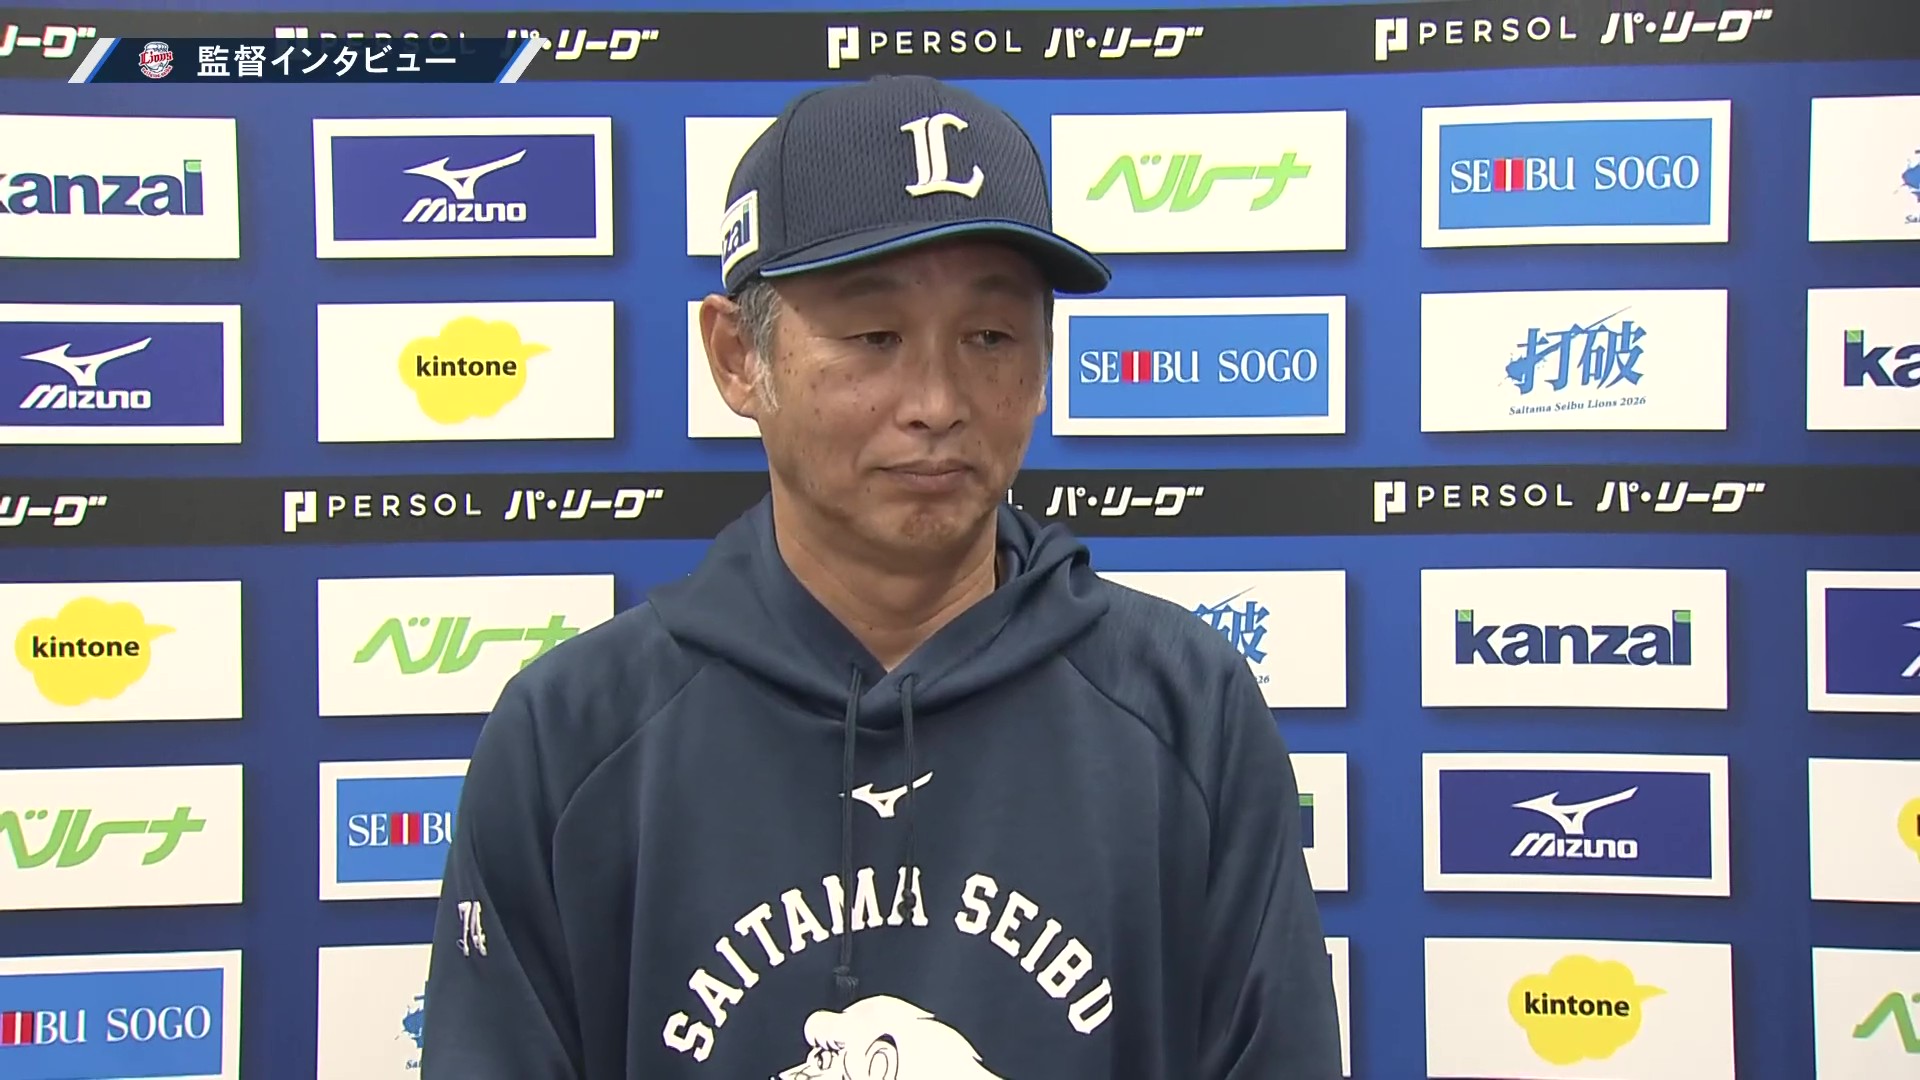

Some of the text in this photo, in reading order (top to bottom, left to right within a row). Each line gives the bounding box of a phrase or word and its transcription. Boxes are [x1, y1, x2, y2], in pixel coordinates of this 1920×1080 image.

[869, 26, 1204, 58] PERSOL パ・リーグ
[1418, 9, 1773, 45] PERSOL パ・リーグ
[901, 112, 985, 200] L
[0, 159, 204, 216] anzai
[1086, 153, 1312, 212] ベルーナ
[1450, 155, 1700, 193] SEIBU SOGO
[416, 355, 517, 378] kintone
[1080, 348, 1318, 383] SEIBU SOGO
[1506, 315, 1647, 395] 打破
[1509, 396, 1647, 415] Saitama Seibu Lions 2026
[327, 488, 664, 521] PERSOL パ・リーグ
[1045, 486, 1205, 517] パ・リーグ
[1417, 480, 1766, 513] PERSOL パ・リーグ
[31, 635, 140, 659] kintone
[1455, 609, 1691, 666] kanzai
[663, 866, 1114, 1062] SAITAMA SEIBU
[1524, 991, 1631, 1018] kintone
[106, 1005, 211, 1042] SOGO
